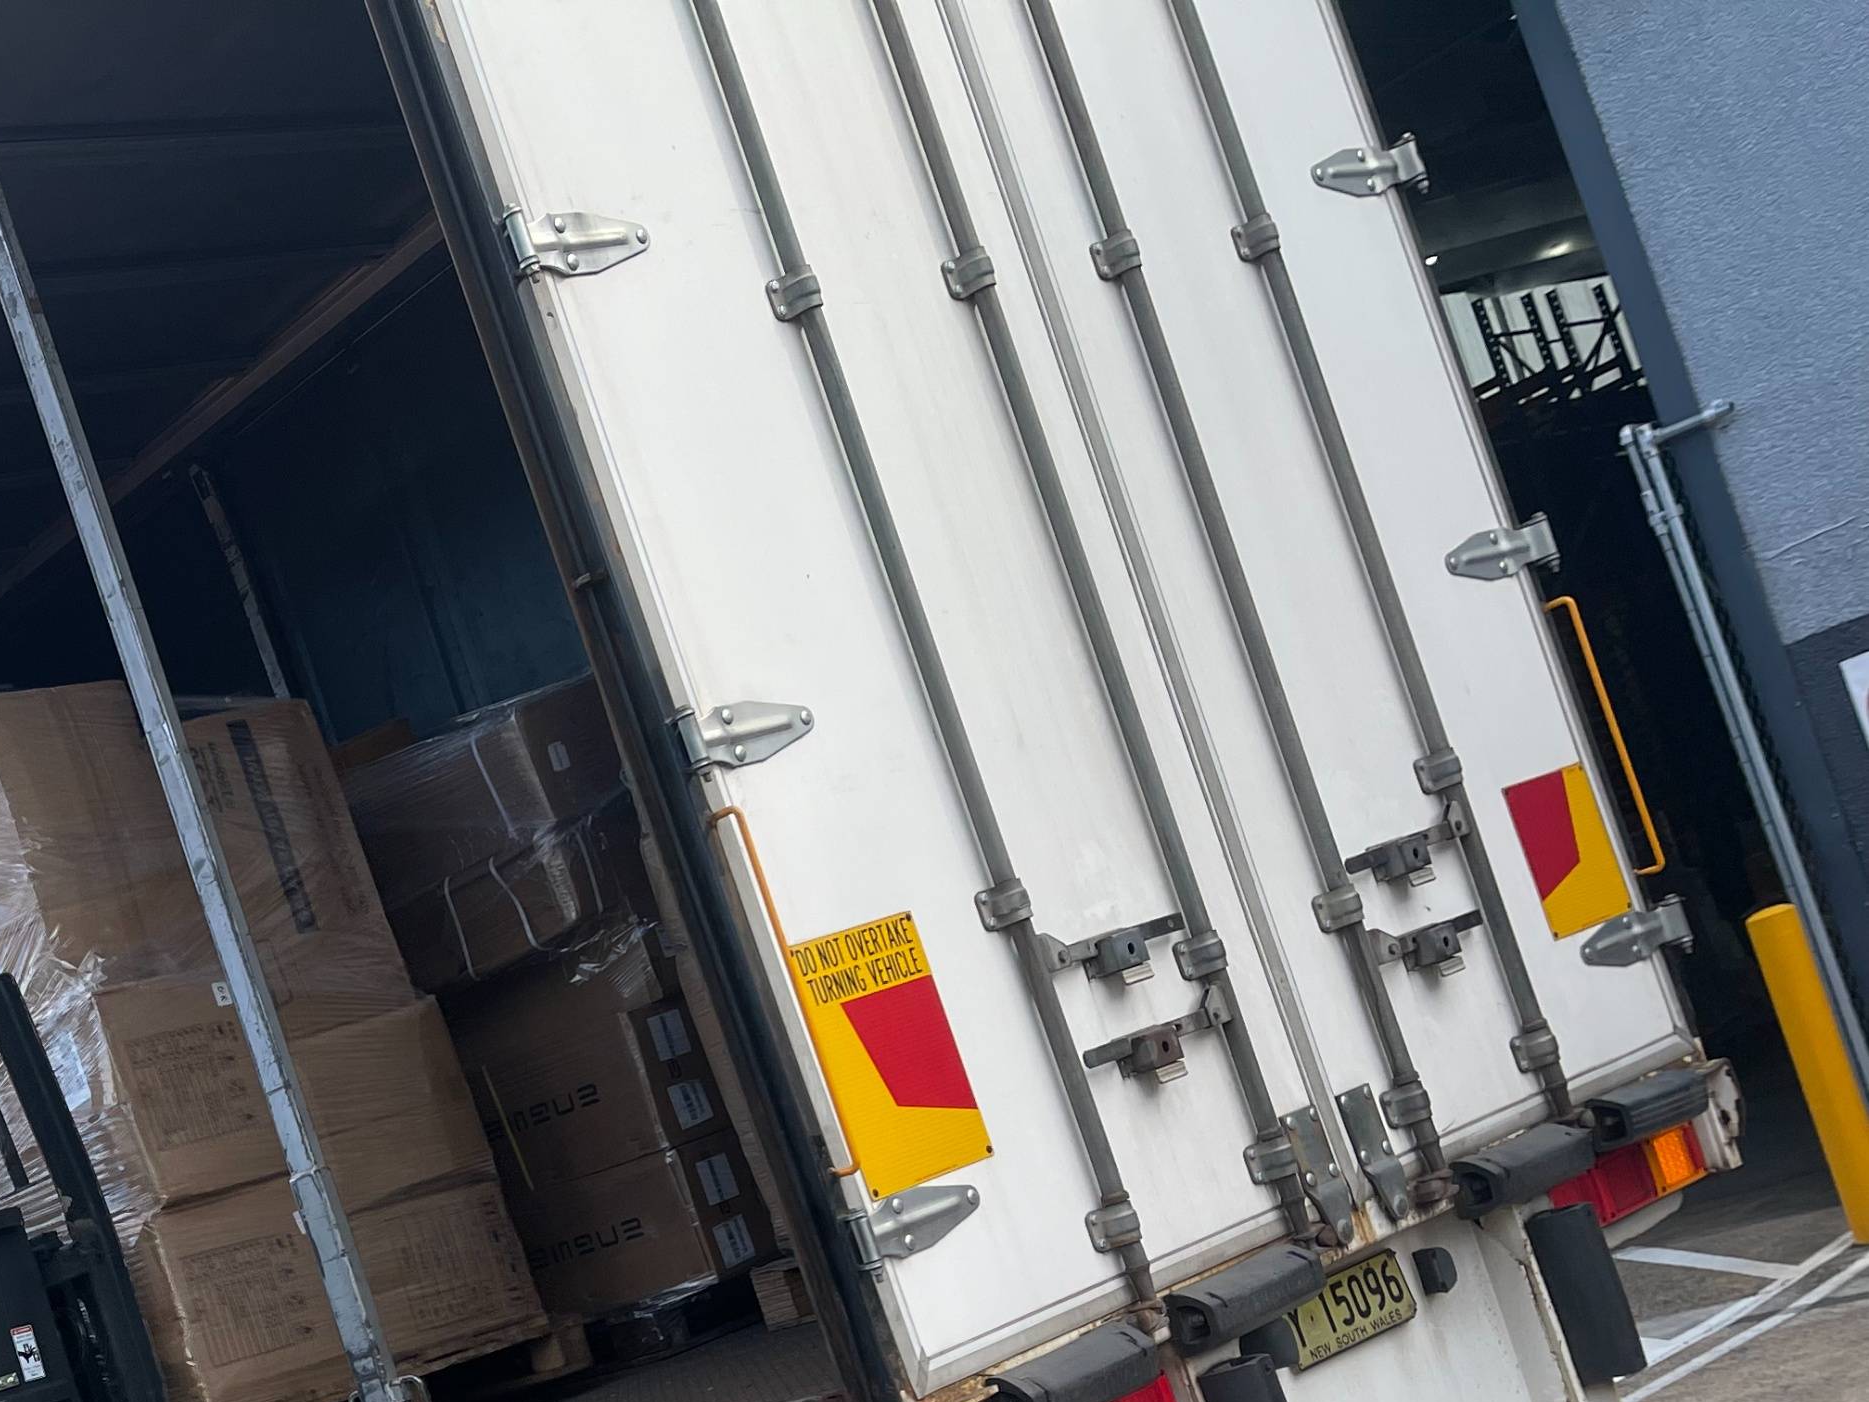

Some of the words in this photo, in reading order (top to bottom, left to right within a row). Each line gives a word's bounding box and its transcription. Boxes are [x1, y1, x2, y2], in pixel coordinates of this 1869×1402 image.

[795, 947, 817, 977] DO
[815, 937, 845, 970] NOT
[845, 917, 914, 961] OVERTAKE
[806, 965, 867, 1006] TURNING
[865, 947, 923, 987] VEHICLE
[1309, 1341, 1332, 1361] NEW
[1335, 1325, 1369, 1349] SOUTH
[1371, 1308, 1403, 1332] WALES
